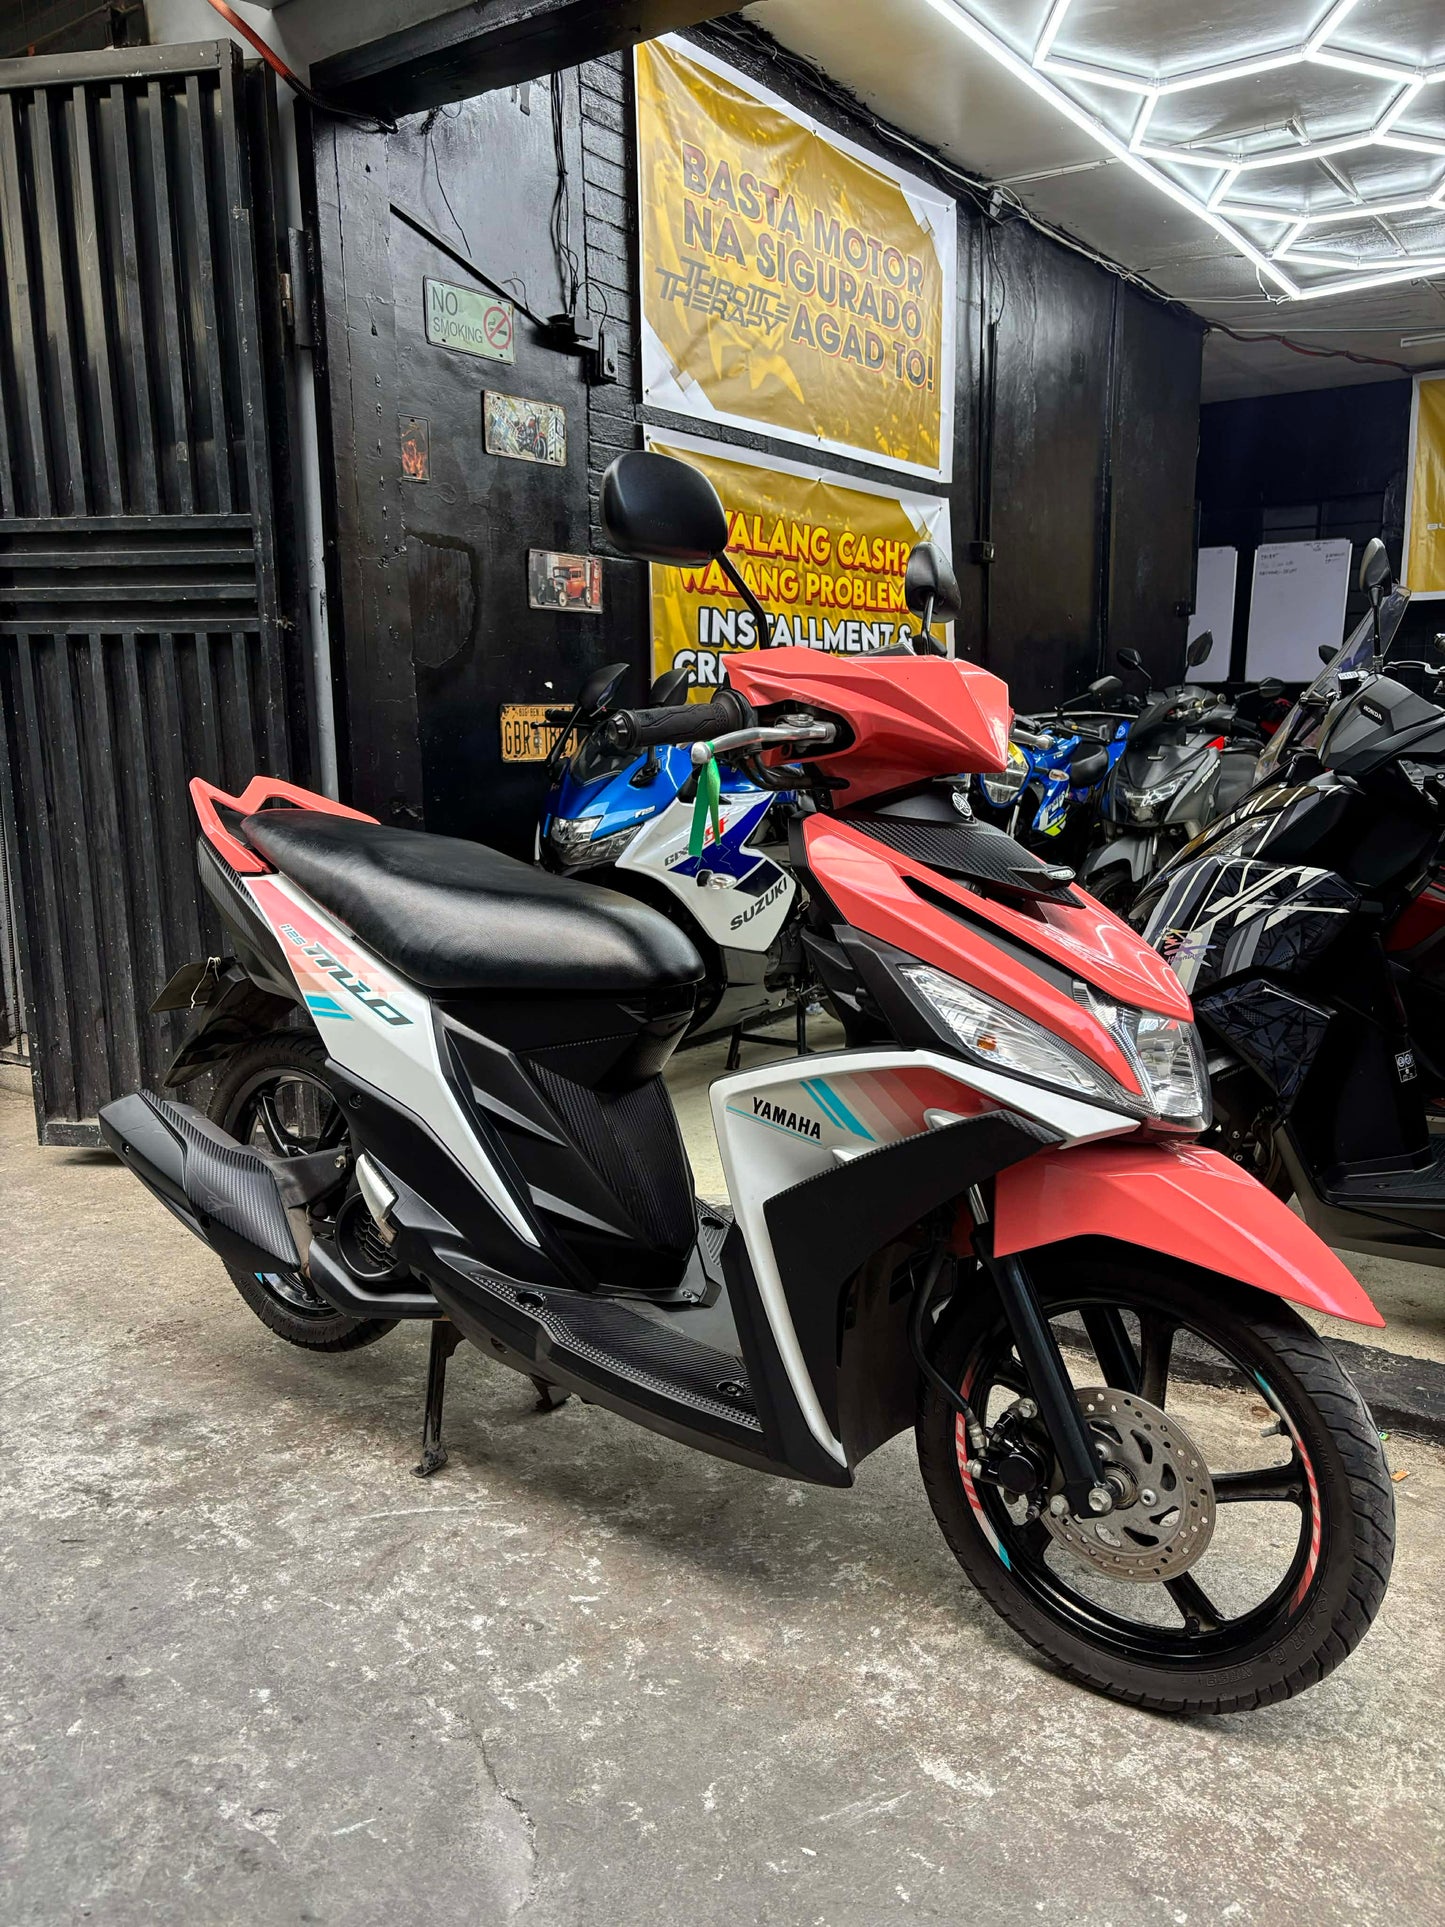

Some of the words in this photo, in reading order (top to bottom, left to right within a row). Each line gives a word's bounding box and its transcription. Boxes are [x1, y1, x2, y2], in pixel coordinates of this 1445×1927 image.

[681, 140, 803, 243] BASTA
[813, 208, 924, 298] MOTOR
[683, 198, 747, 270] NA
[756, 232, 922, 342] SIGURADO
[432, 286, 458, 316] NO
[655, 267, 781, 336] THERAPY
[433, 316, 483, 344] SMOKING
[790, 304, 886, 375] AGAD
[893, 341, 934, 392] TO!
[725, 509, 832, 564] ALANG
[838, 531, 910, 577] CASH?
[505, 721, 530, 755] GBR
[1363, 704, 1382, 720] HONDA
[730, 877, 789, 931] SUZUKI
[753, 1097, 821, 1139] YAMAHA
